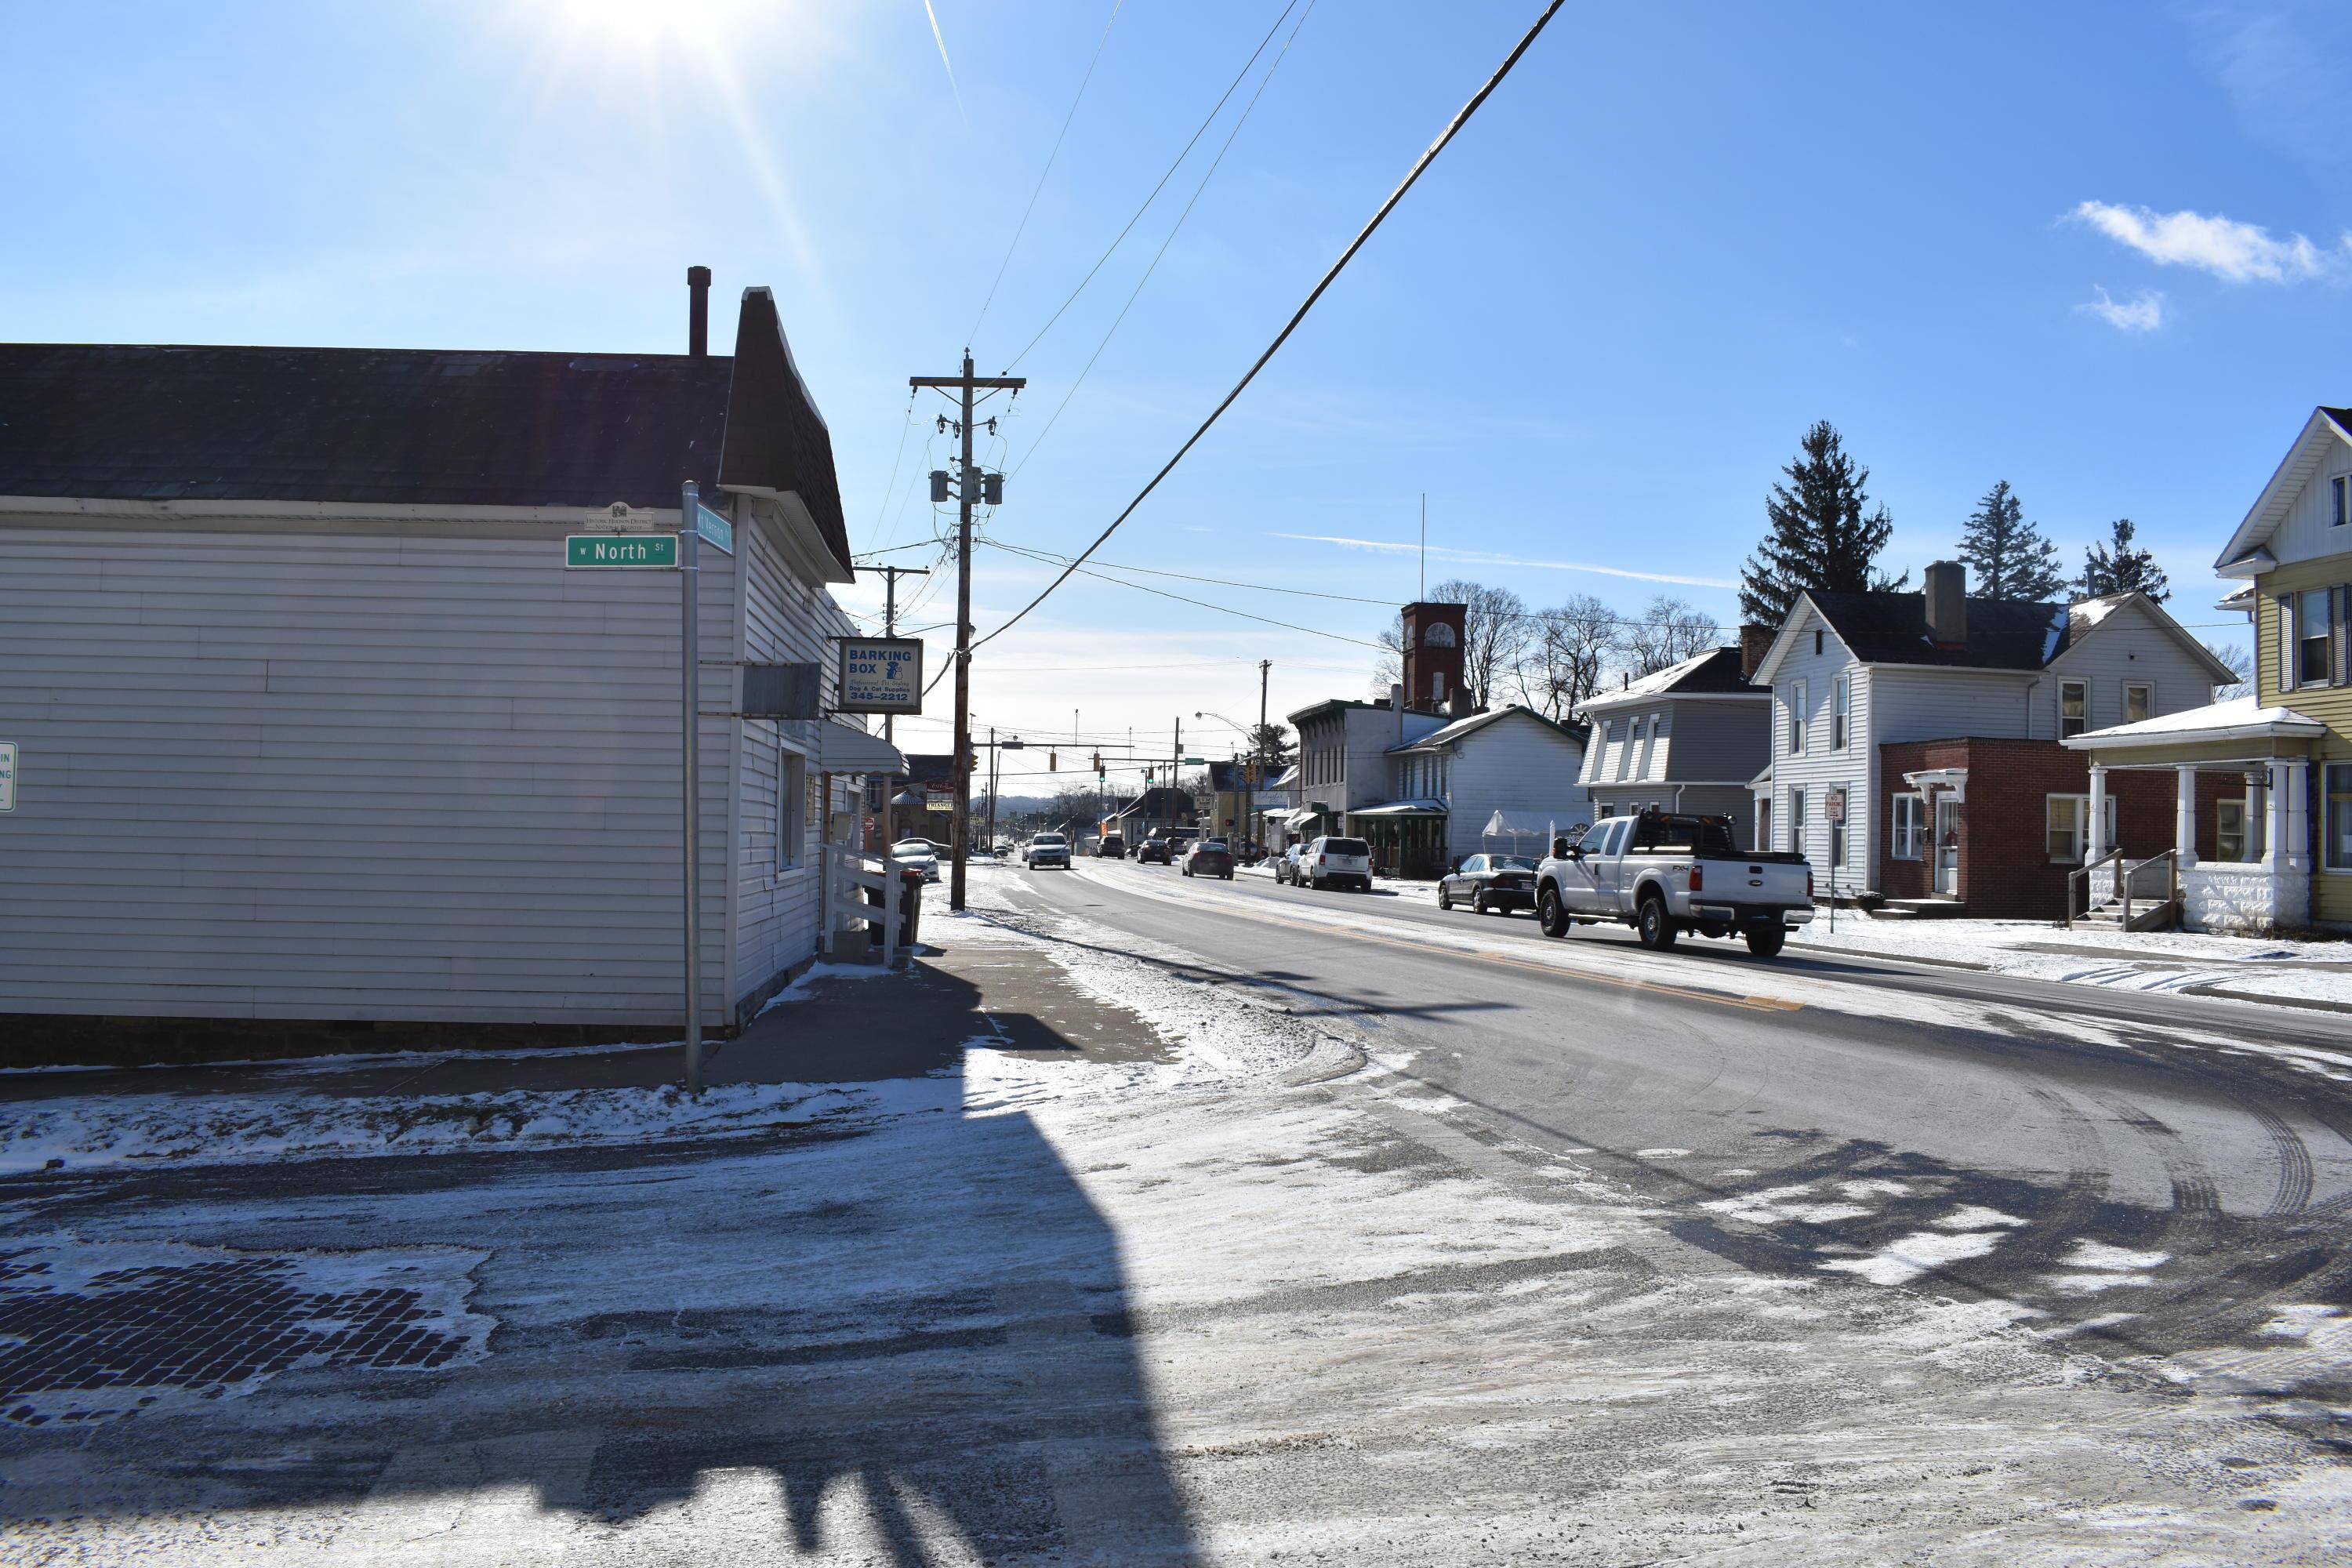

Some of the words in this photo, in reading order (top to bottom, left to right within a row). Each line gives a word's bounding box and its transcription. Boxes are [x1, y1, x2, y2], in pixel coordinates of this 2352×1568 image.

[596, 543, 646, 559] North
[849, 650, 912, 662] BARKING
[849, 663, 877, 674] BOX
[850, 692, 908, 701] 345-2212
